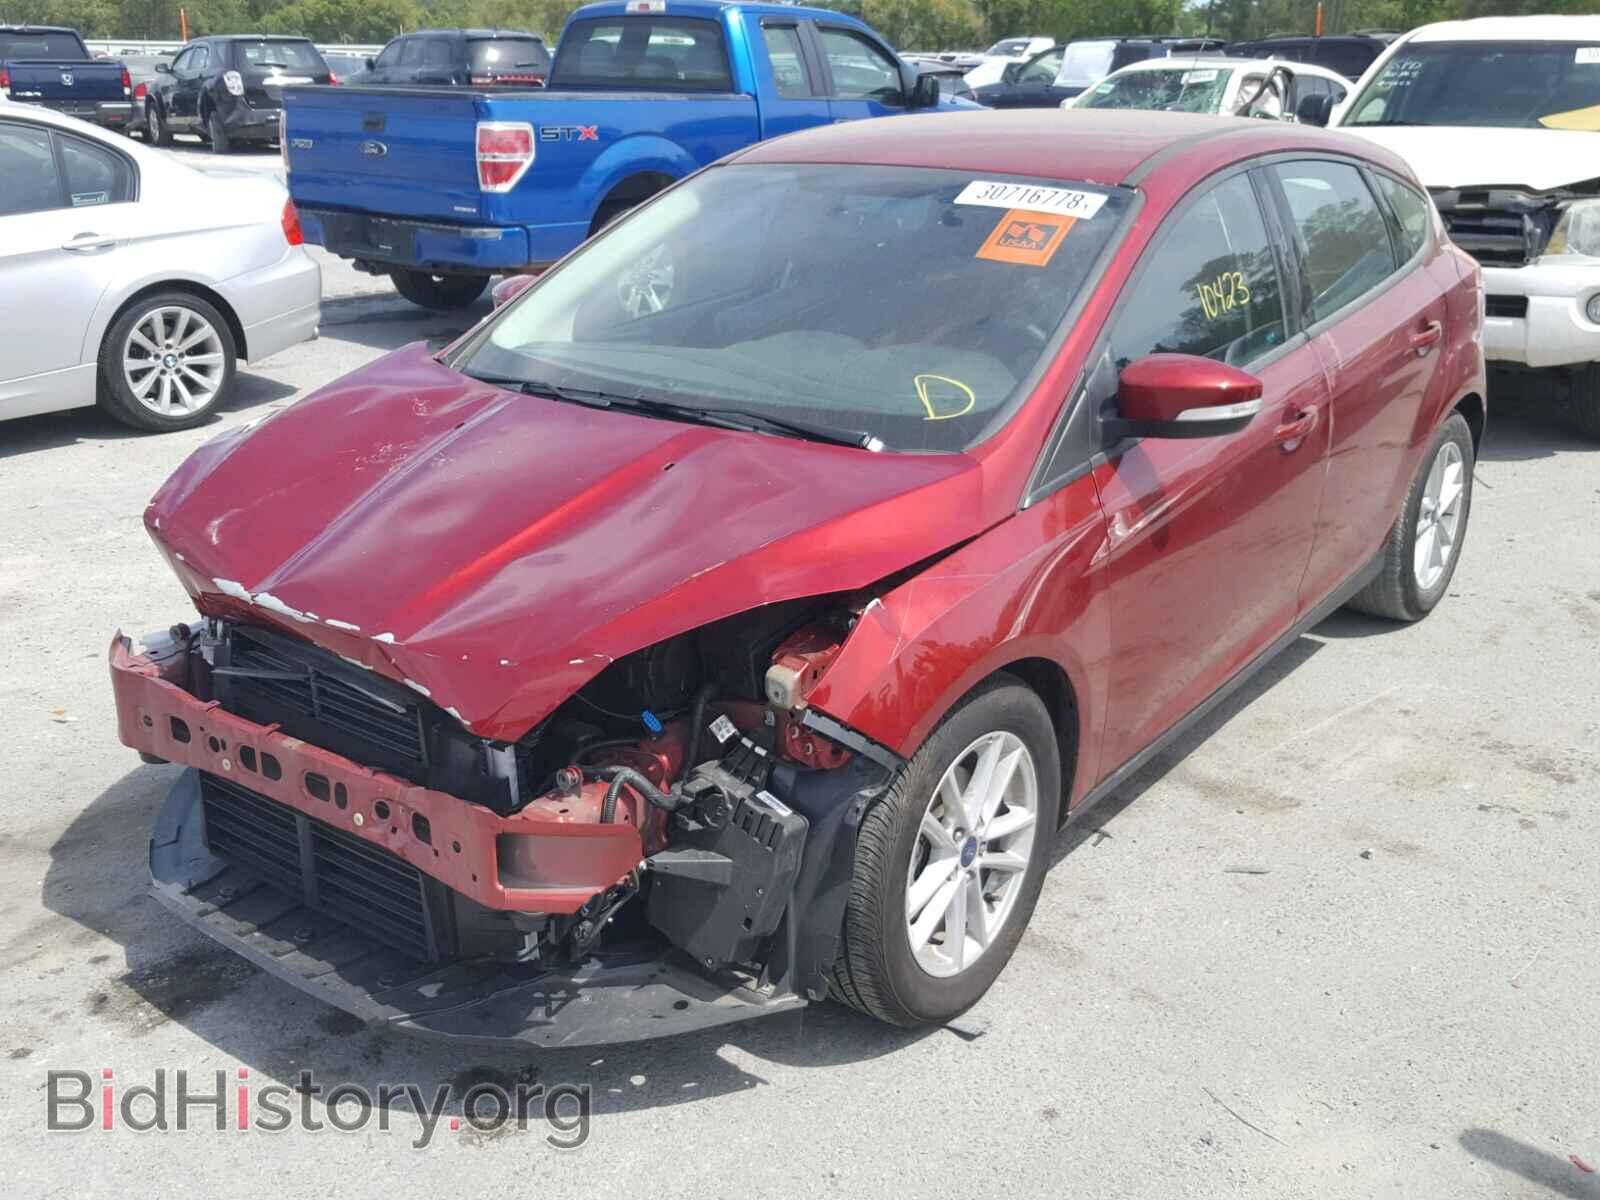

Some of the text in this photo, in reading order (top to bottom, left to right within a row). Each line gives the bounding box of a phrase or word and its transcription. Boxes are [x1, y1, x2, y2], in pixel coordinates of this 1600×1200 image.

[540, 125, 599, 141] STX
[976, 184, 1085, 210] 30716778
[1196, 271, 1250, 320] 10423
[914, 374, 975, 420] D
